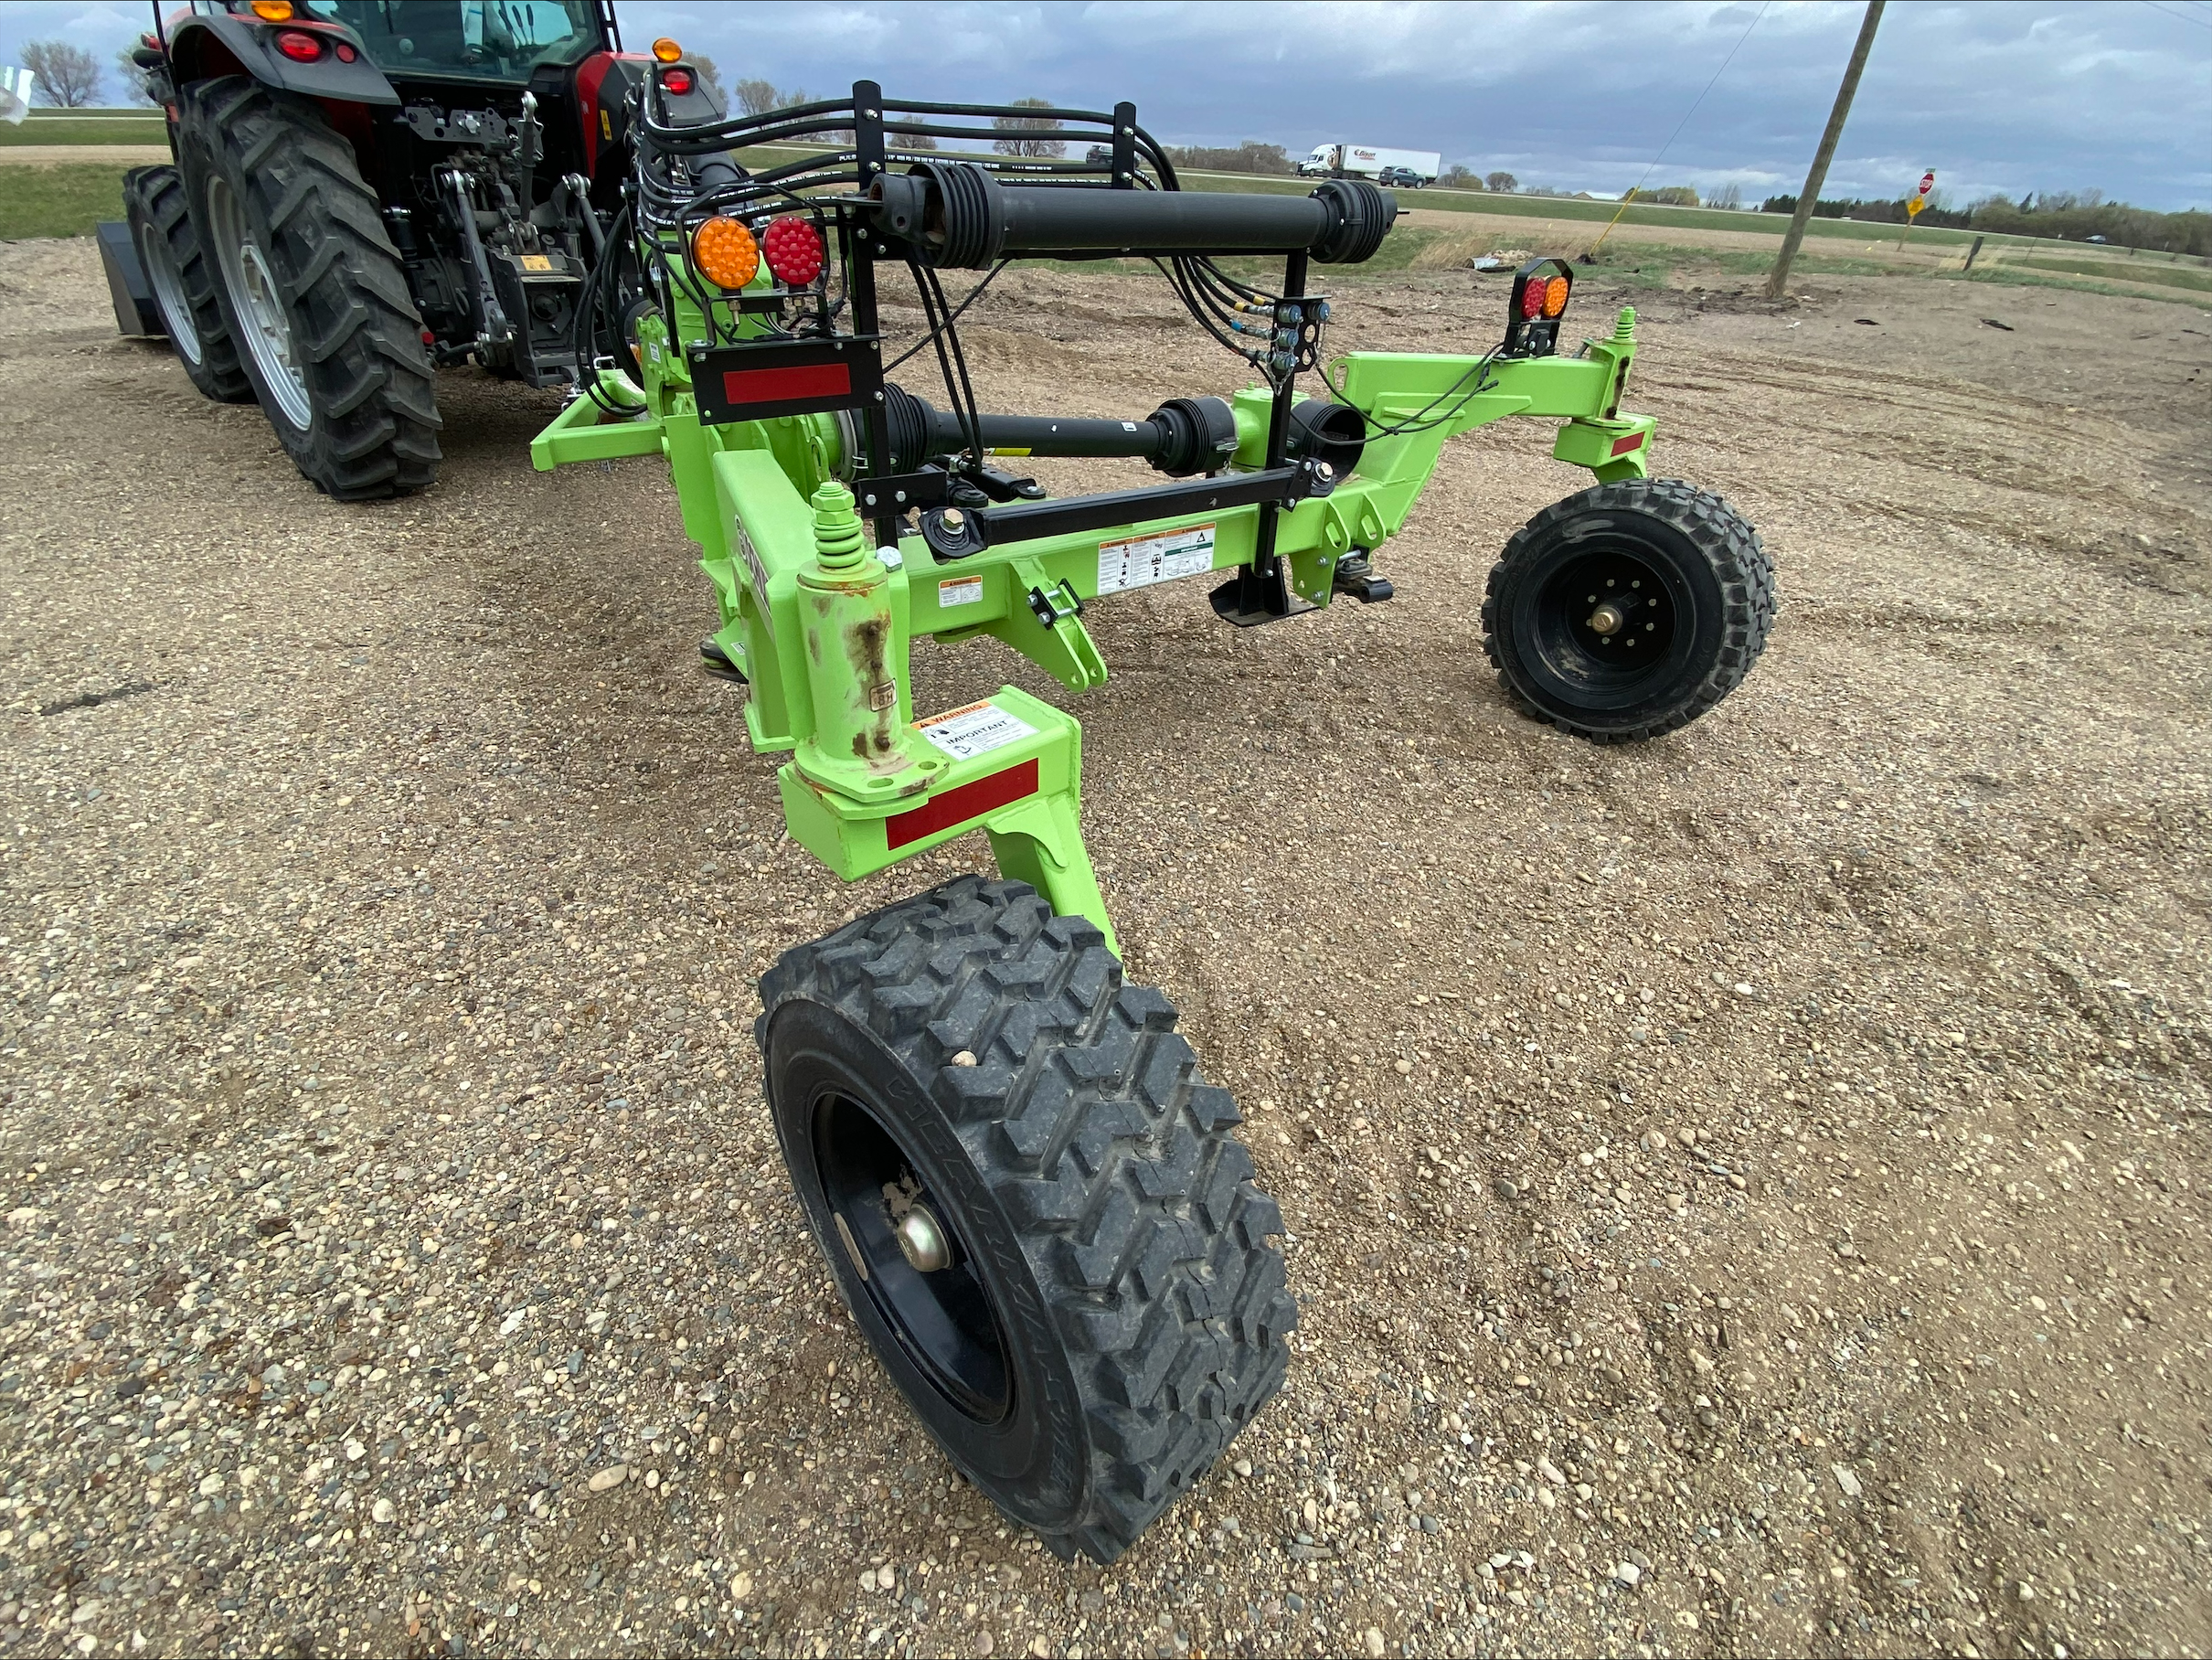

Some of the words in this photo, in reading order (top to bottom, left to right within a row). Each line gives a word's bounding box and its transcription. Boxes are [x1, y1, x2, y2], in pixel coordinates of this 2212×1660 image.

[1920, 179, 1933, 188] STOP
[934, 704, 983, 723] WARNING
[946, 719, 1008, 745] IMPORTANT
